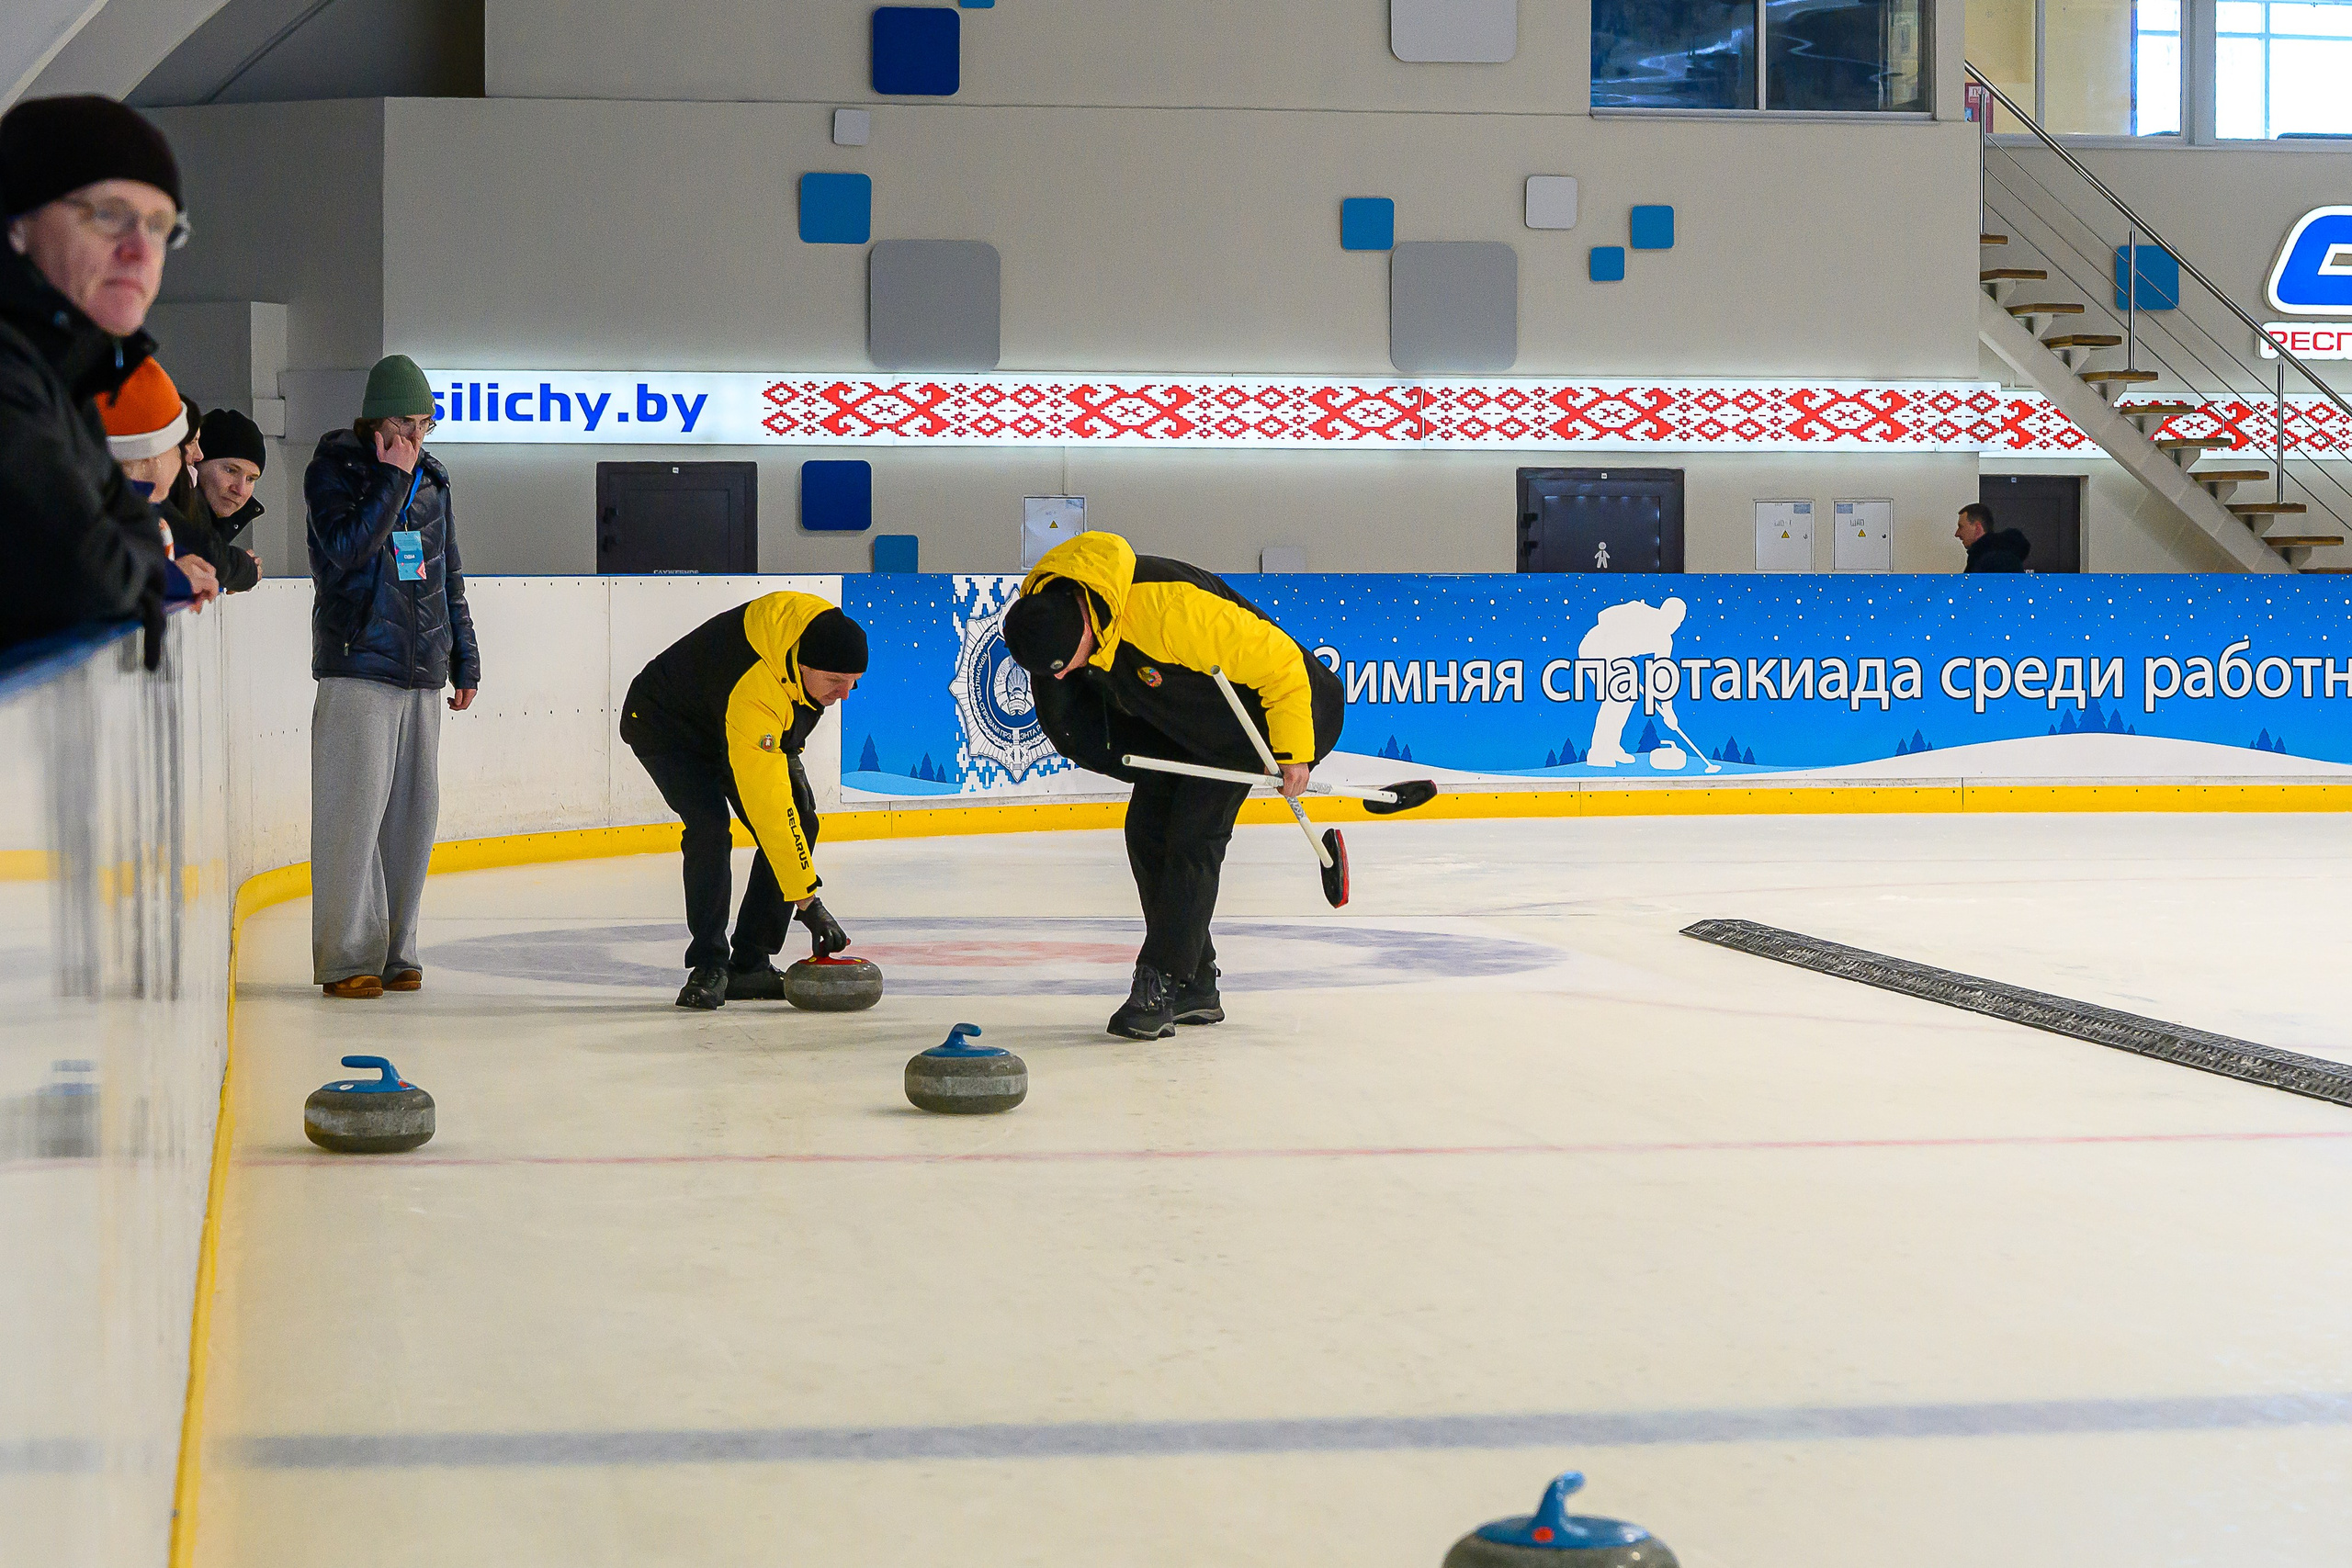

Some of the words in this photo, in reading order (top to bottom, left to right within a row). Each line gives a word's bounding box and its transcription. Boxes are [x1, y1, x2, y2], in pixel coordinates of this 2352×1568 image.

[1541, 656, 1923, 716] спартакиада
[1939, 656, 2124, 713] среди
[2143, 639, 2352, 713] работн
[786, 807, 809, 871] BELARUS
